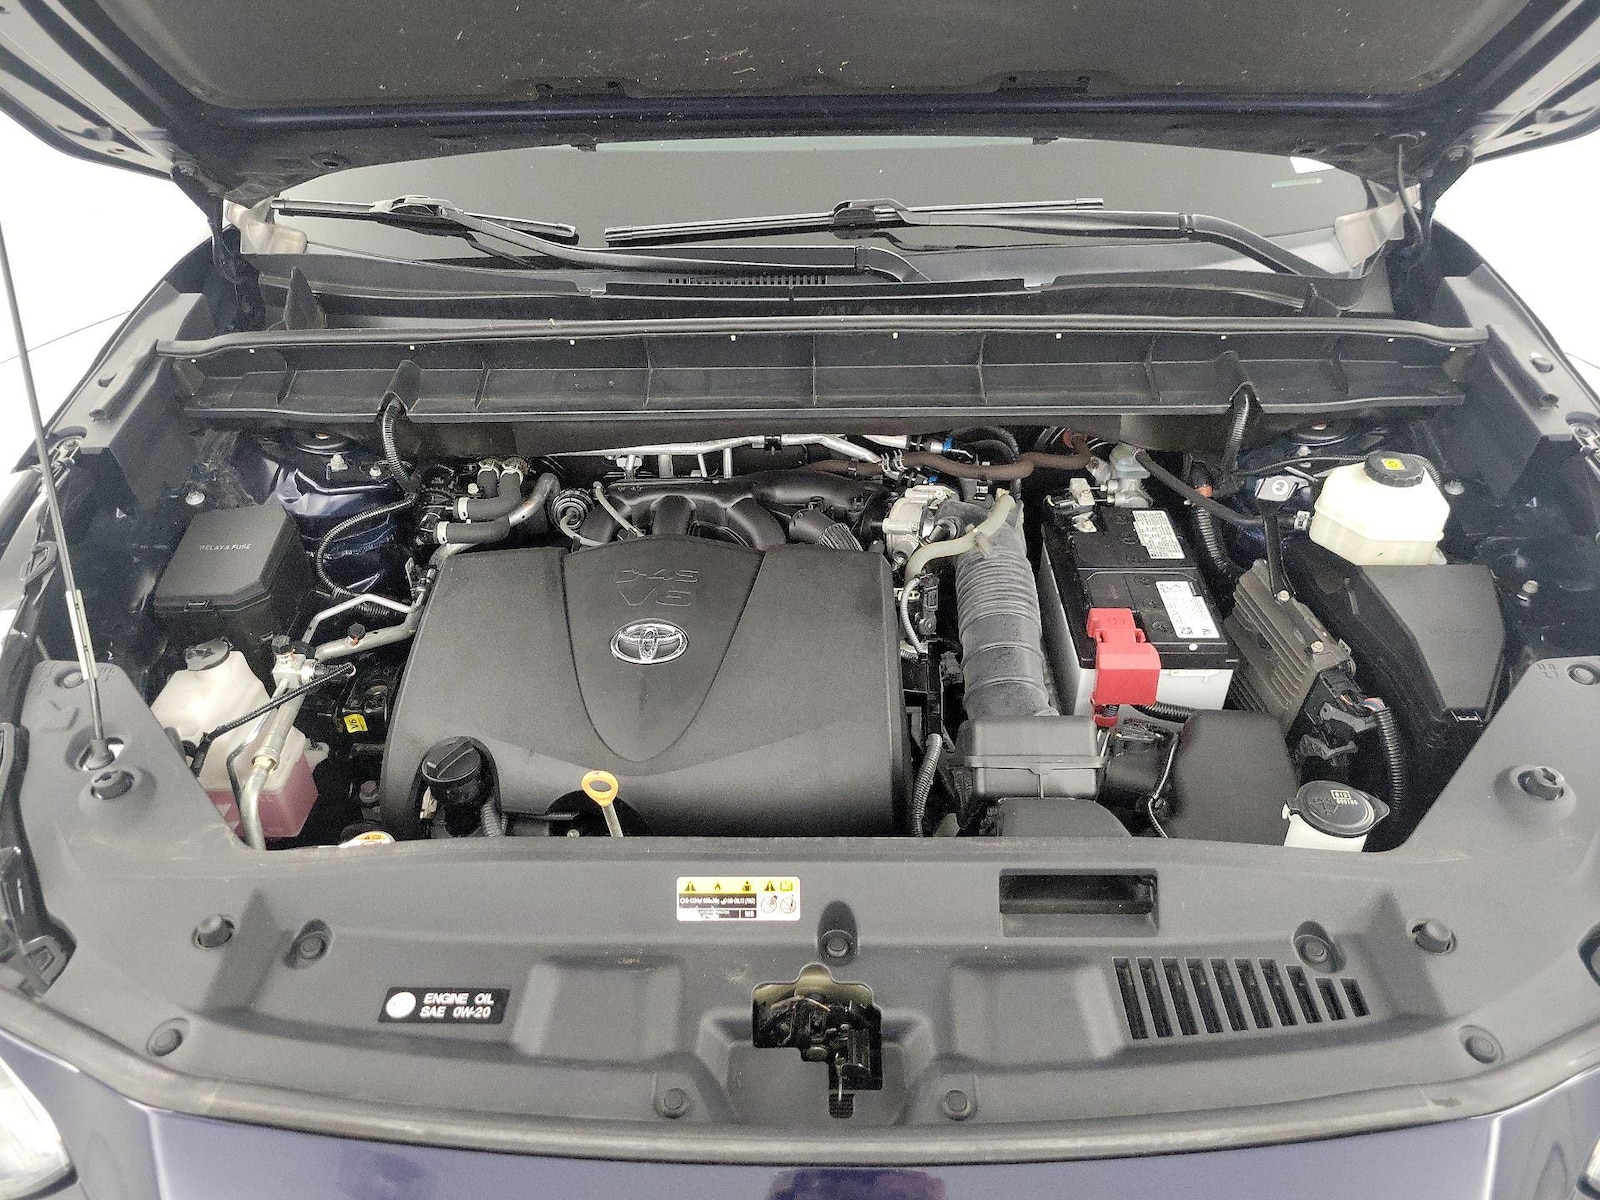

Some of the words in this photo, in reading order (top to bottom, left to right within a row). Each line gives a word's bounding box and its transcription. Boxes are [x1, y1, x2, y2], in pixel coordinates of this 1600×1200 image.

[618, 586, 693, 607] V6
[423, 992, 470, 1005] ENGINE
[474, 992, 495, 1005] OIL
[419, 1005, 447, 1018] SAE
[452, 1005, 492, 1018] 0W-20
